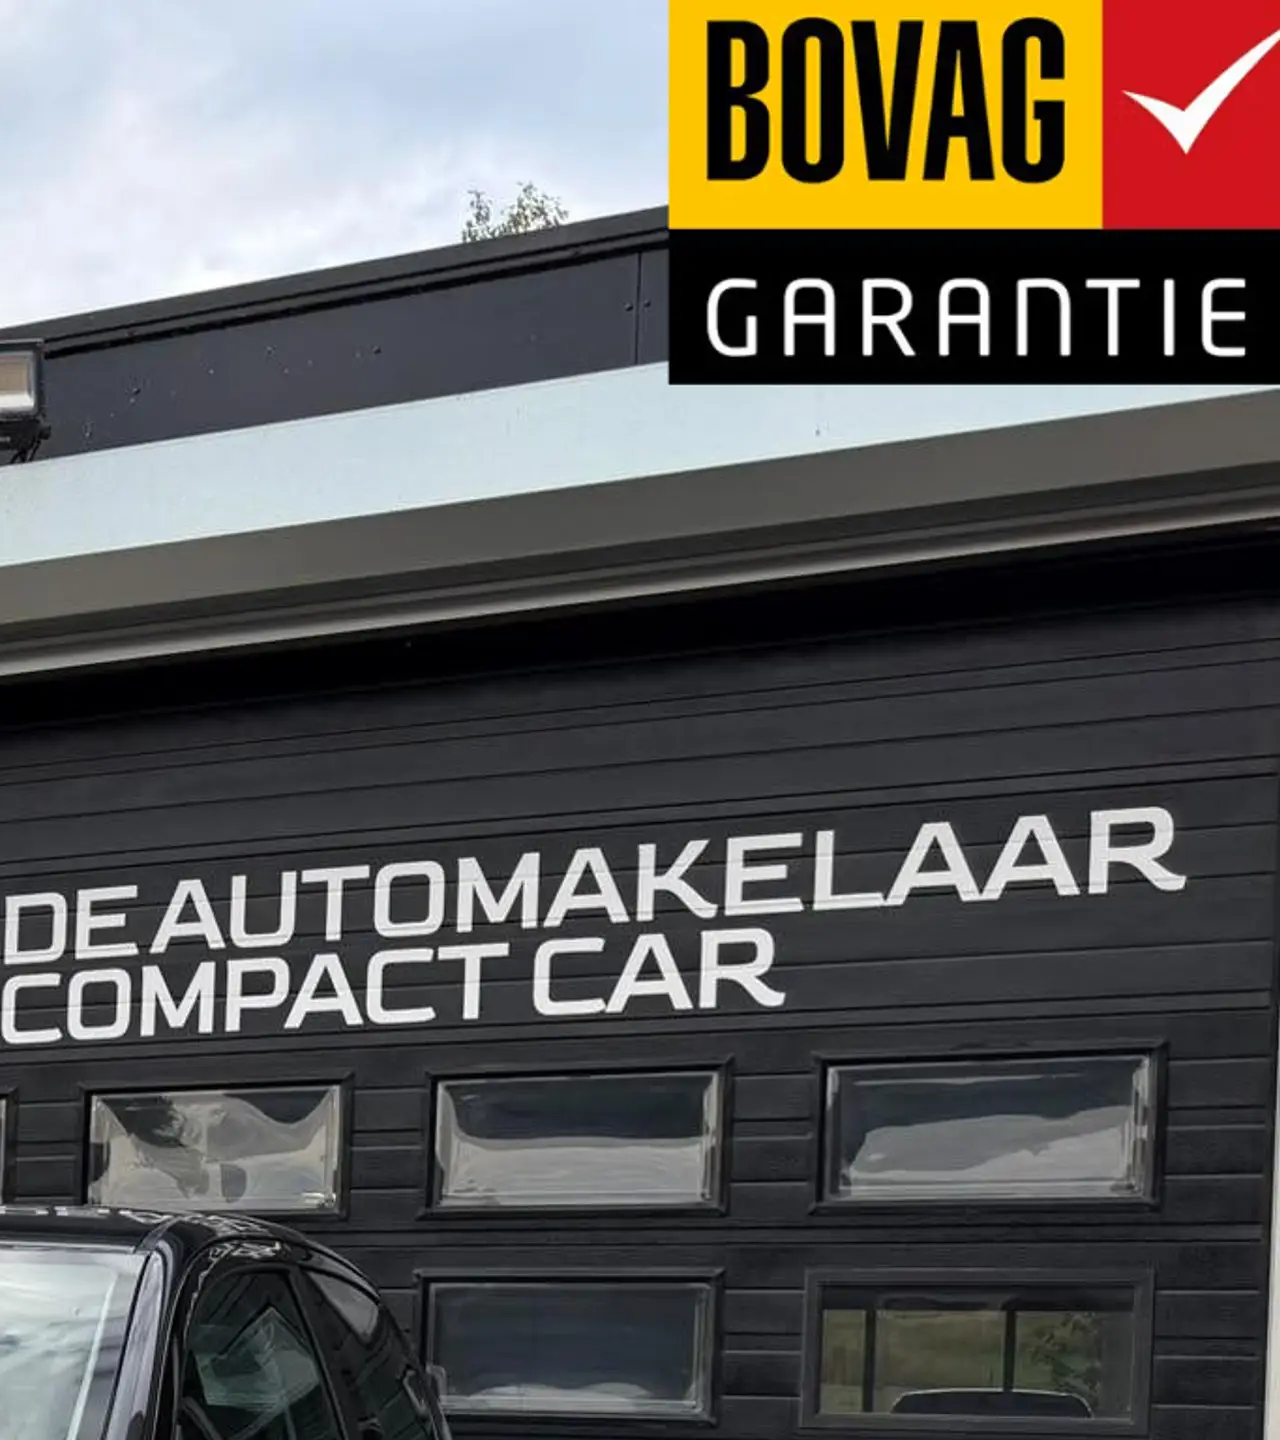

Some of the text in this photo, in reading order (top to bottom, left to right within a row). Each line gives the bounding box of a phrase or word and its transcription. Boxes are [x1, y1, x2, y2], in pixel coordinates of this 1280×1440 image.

[3, 806, 1187, 966] DE AUTOMAKELAAR
[0, 927, 786, 1044] COMPACT CAR
